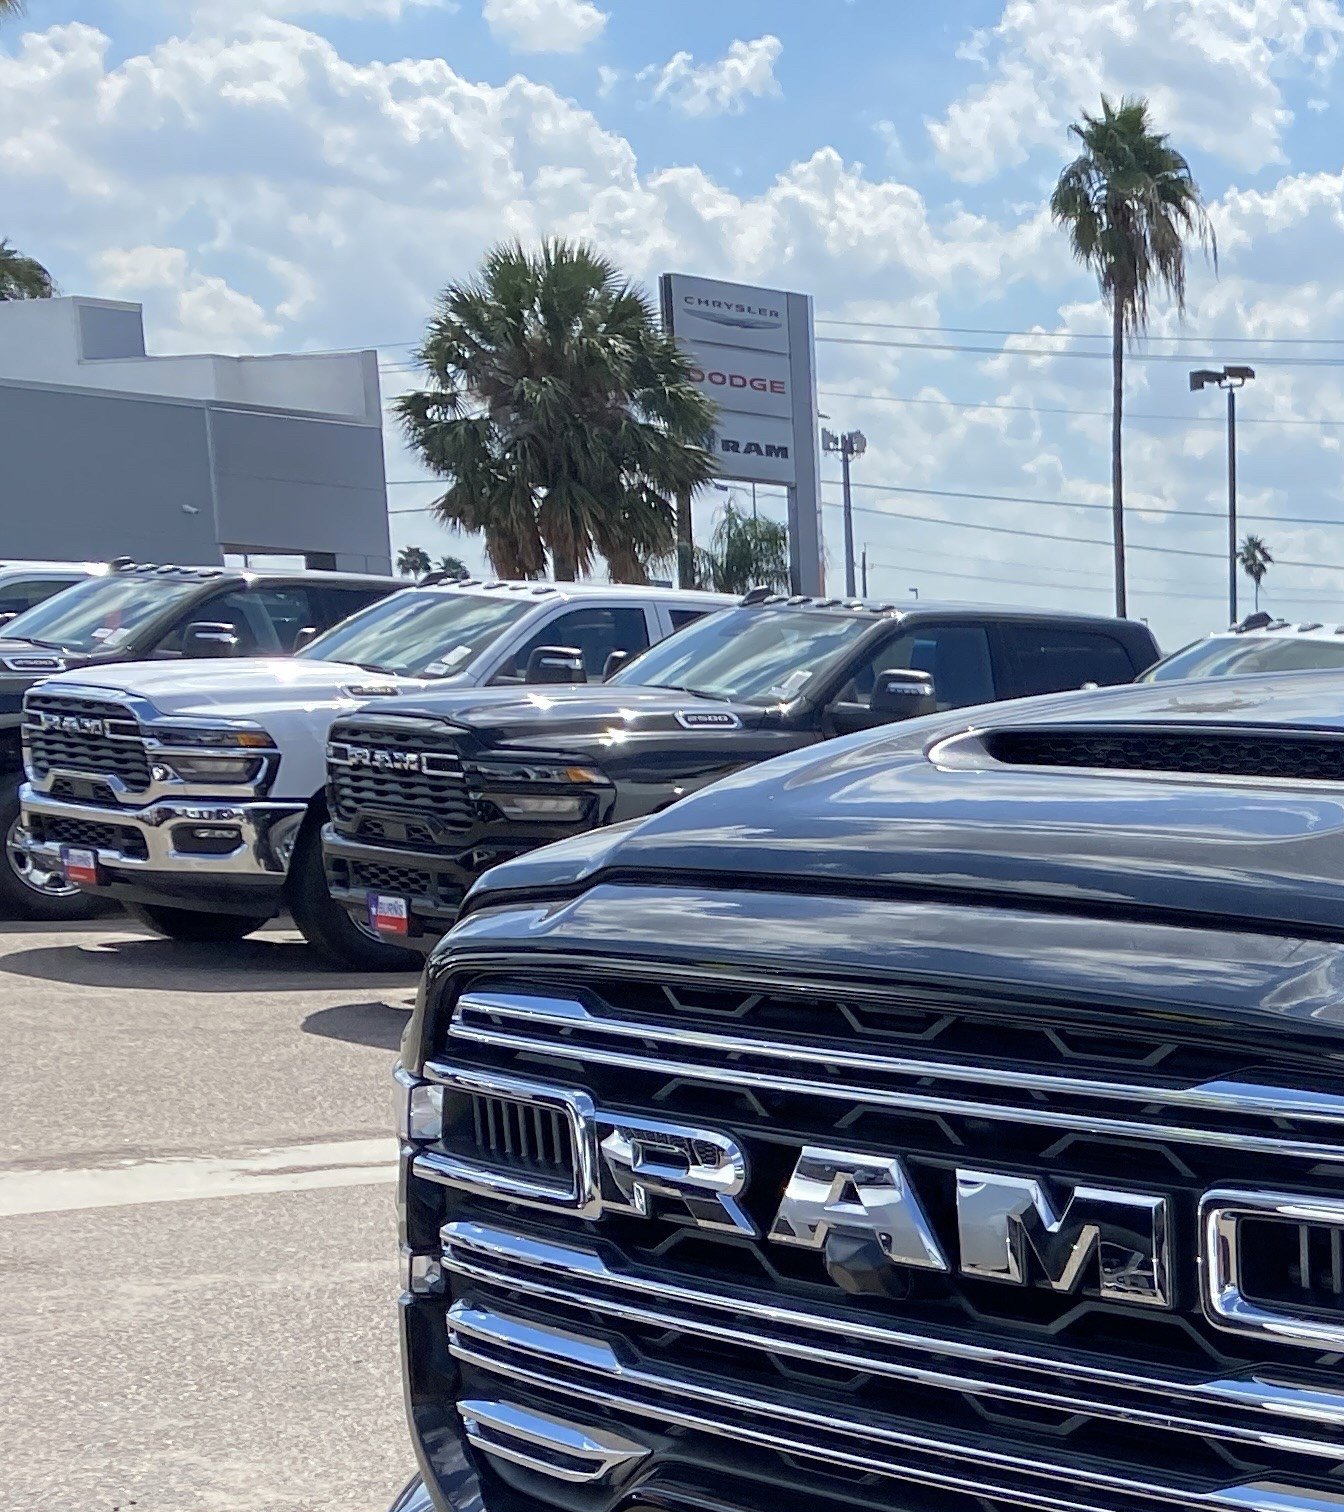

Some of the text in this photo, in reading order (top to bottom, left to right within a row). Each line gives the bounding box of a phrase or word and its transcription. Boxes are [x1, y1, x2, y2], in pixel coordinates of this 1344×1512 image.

[683, 295, 780, 319] CHRYSLER
[684, 367, 786, 394] DODGE
[720, 439, 789, 459] RAM
[347, 747, 419, 771] RAM
[597, 1110, 1172, 1307] RAM
